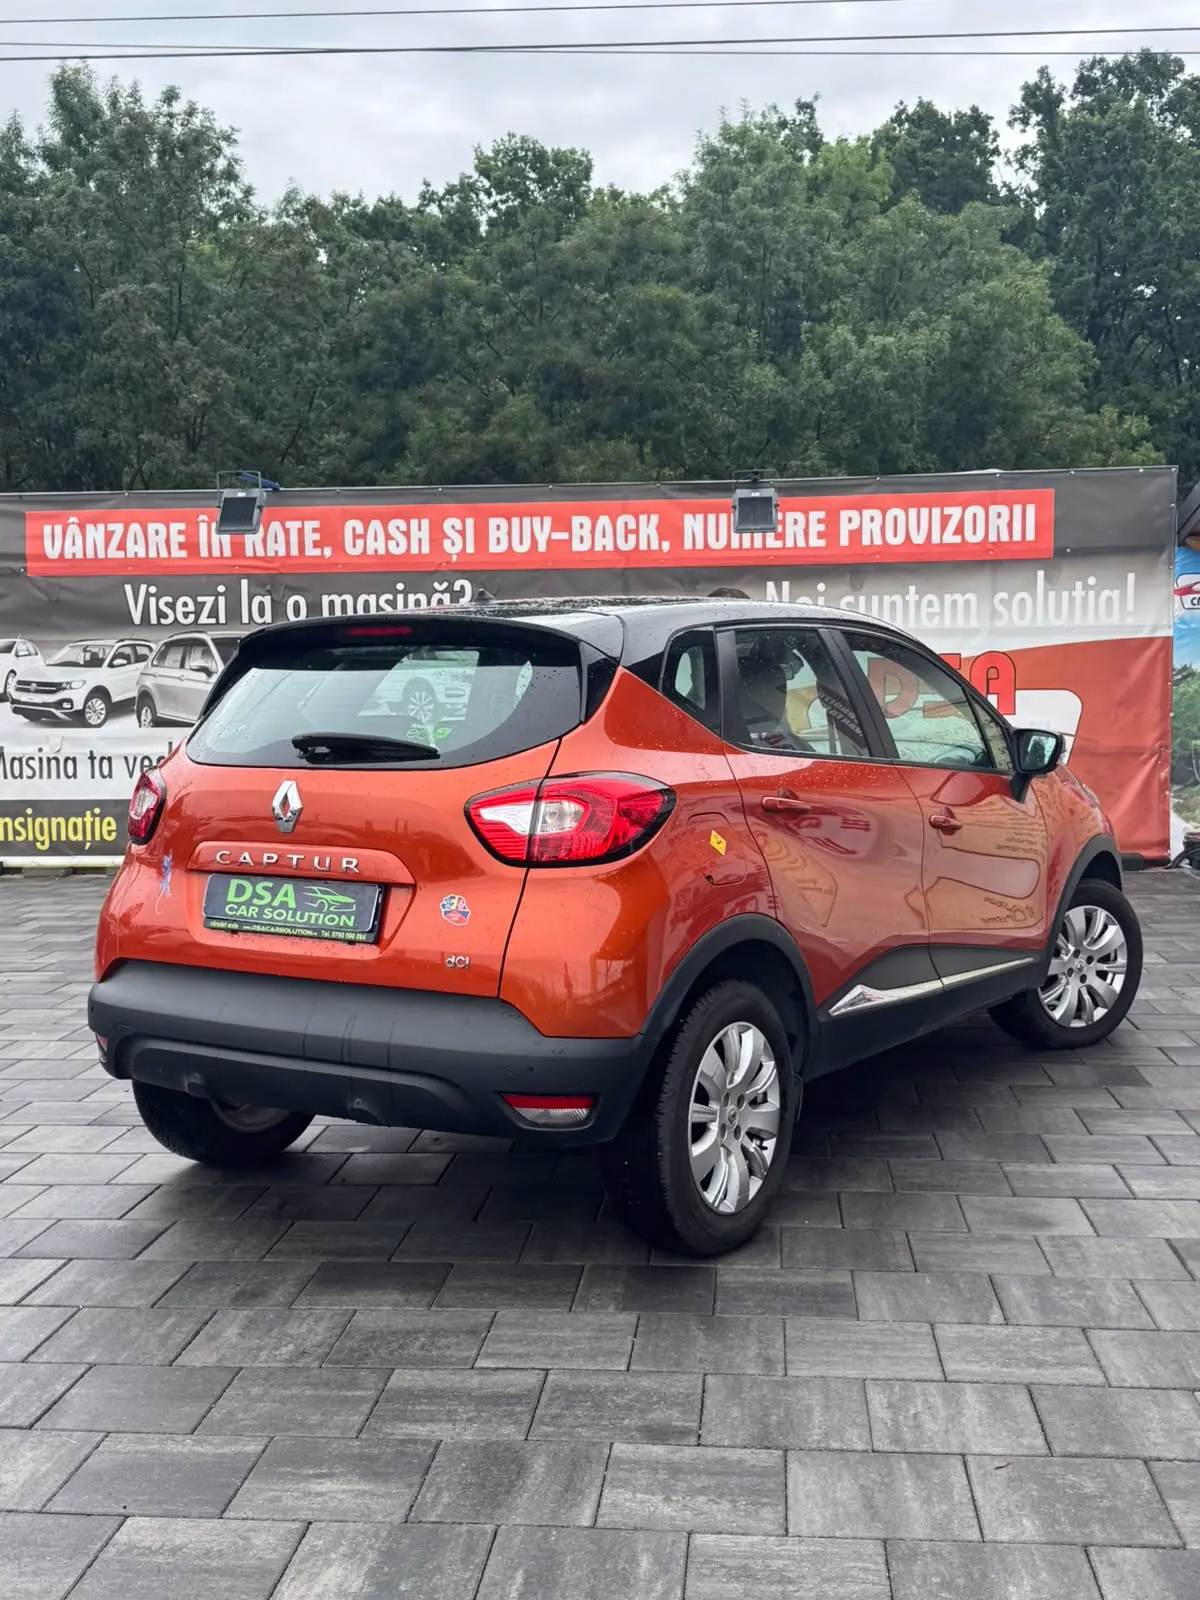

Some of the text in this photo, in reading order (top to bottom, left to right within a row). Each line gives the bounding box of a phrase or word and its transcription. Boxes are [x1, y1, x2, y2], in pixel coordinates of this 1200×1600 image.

[43, 516, 187, 559] VÂNZARE
[244, 520, 332, 559] RATE,
[344, 518, 430, 555] CASH
[443, 517, 475, 562] ȘI
[488, 514, 670, 553] BUY-BACK,
[839, 504, 1035, 546] PROVIZORII
[124, 583, 226, 625] Visezi
[240, 579, 272, 625] la
[286, 594, 308, 622] o
[992, 570, 1136, 627] solutia!
[88, 750, 113, 779] ta
[216, 850, 360, 874] CAPTUR
[226, 878, 297, 909] DSA
[225, 903, 355, 927] CAR SOLUTION
